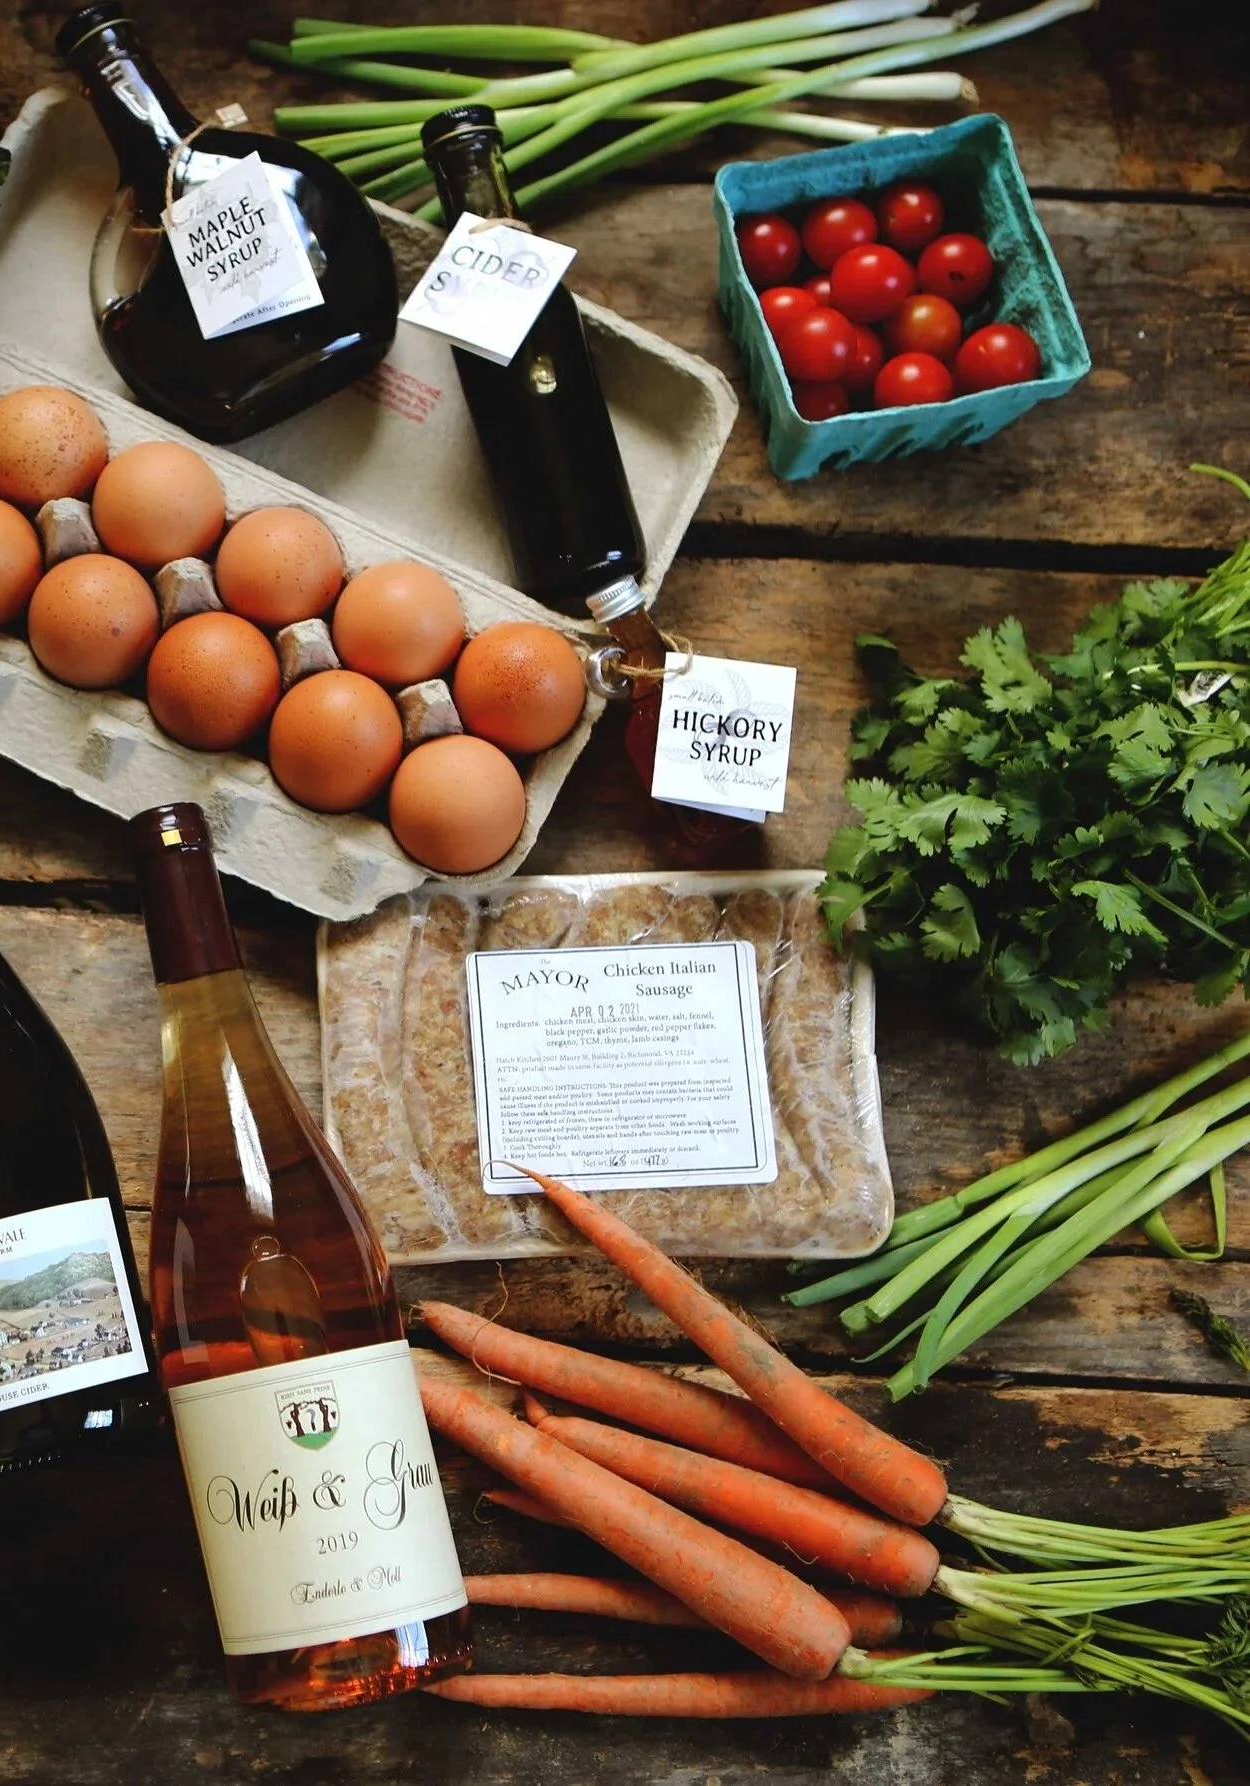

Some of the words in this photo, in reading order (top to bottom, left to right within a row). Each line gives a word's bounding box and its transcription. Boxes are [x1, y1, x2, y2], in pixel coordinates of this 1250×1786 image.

[188, 196, 253, 248] MAPLE
[186, 207, 266, 267] WALNUT
[207, 237, 262, 281] SYRUP
[451, 246, 540, 290] CIDER
[257, 305, 276, 315] After
[278, 294, 311, 309] Opening
[673, 709, 783, 742] HICKORY
[689, 740, 762, 767] SYRUP
[732, 773, 780, 791] harvest
[603, 962, 665, 977] Chicken
[670, 961, 716, 975] Italian
[501, 970, 590, 996] MAYOR
[636, 983, 693, 999] Sausage
[544, 1018, 574, 1026] chicken
[597, 1016, 627, 1024] chicken
[570, 1006, 592, 1018] APR
[620, 1003, 639, 1014] 2021
[597, 1026, 618, 1036] garlic
[665, 1024, 691, 1033] pepper
[632, 1035, 651, 1043] lamb
[652, 1035, 679, 1043] casings
[20, 1383, 50, 1396] CIDER
[207, 1469, 300, 1533] Weiß
[313, 1471, 347, 1511] &
[363, 1439, 434, 1530] Grau
[318, 1530, 359, 1555] 2019
[290, 1580, 347, 1606] Enderle
[350, 1576, 363, 1593] &
